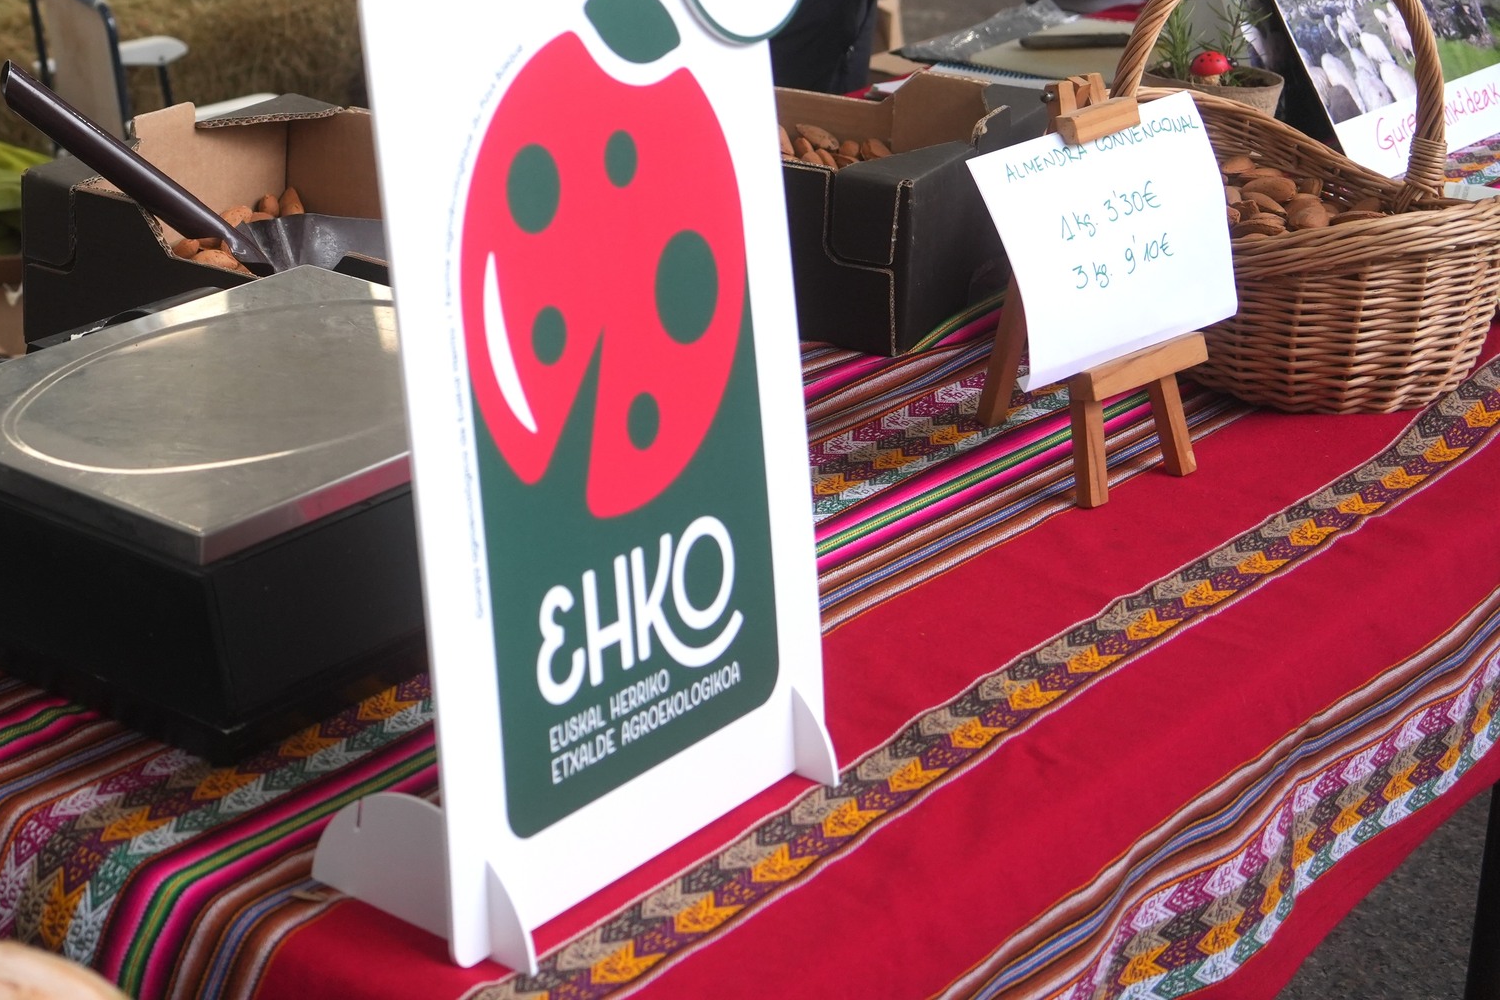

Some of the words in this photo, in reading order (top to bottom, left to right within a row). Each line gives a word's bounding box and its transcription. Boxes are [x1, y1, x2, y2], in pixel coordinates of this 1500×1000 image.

[1005, 144, 1087, 183] ALMENDRA
[1095, 115, 1199, 152] CONVENCIONAL
[1072, 265, 1088, 289] 3
[536, 515, 744, 706] EHKO
[549, 704, 607, 754] EUSKAL
[609, 668, 670, 722] HERRIKO
[550, 727, 617, 785] ETXALDE
[621, 660, 742, 747] AGROEKOLOGIKOA
